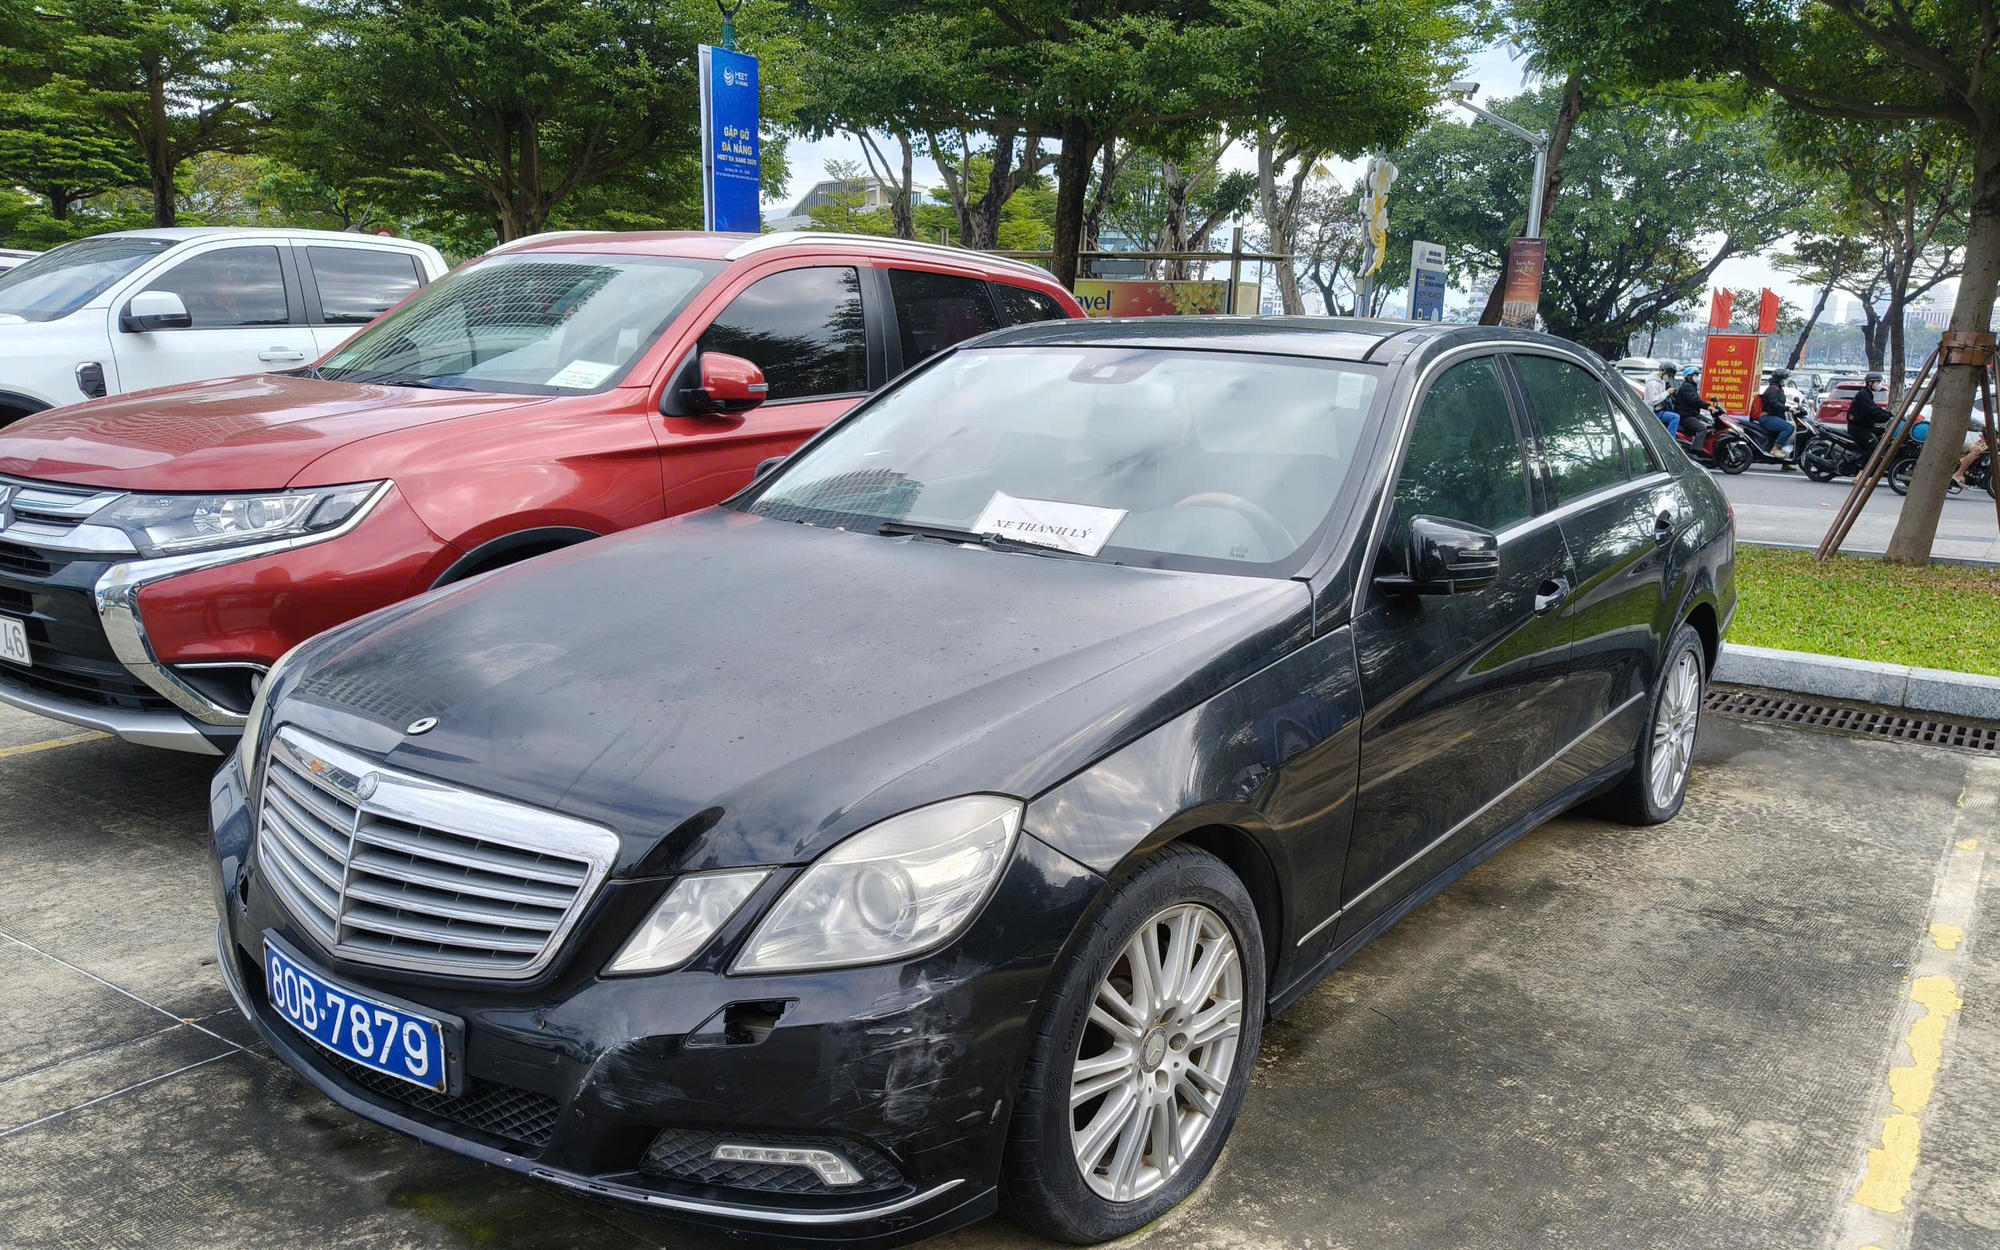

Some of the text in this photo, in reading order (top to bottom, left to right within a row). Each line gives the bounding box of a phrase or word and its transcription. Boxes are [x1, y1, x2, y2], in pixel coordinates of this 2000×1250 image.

[735, 71, 748, 81] MEET
[724, 125, 738, 140] GẶP
[722, 140, 752, 156] ĐÀ NẴNG
[717, 153, 728, 161] MEET
[736, 156, 747, 164] NANG
[1731, 360, 1742, 368] TẬP
[992, 519, 1093, 539] XE THANH LÝ
